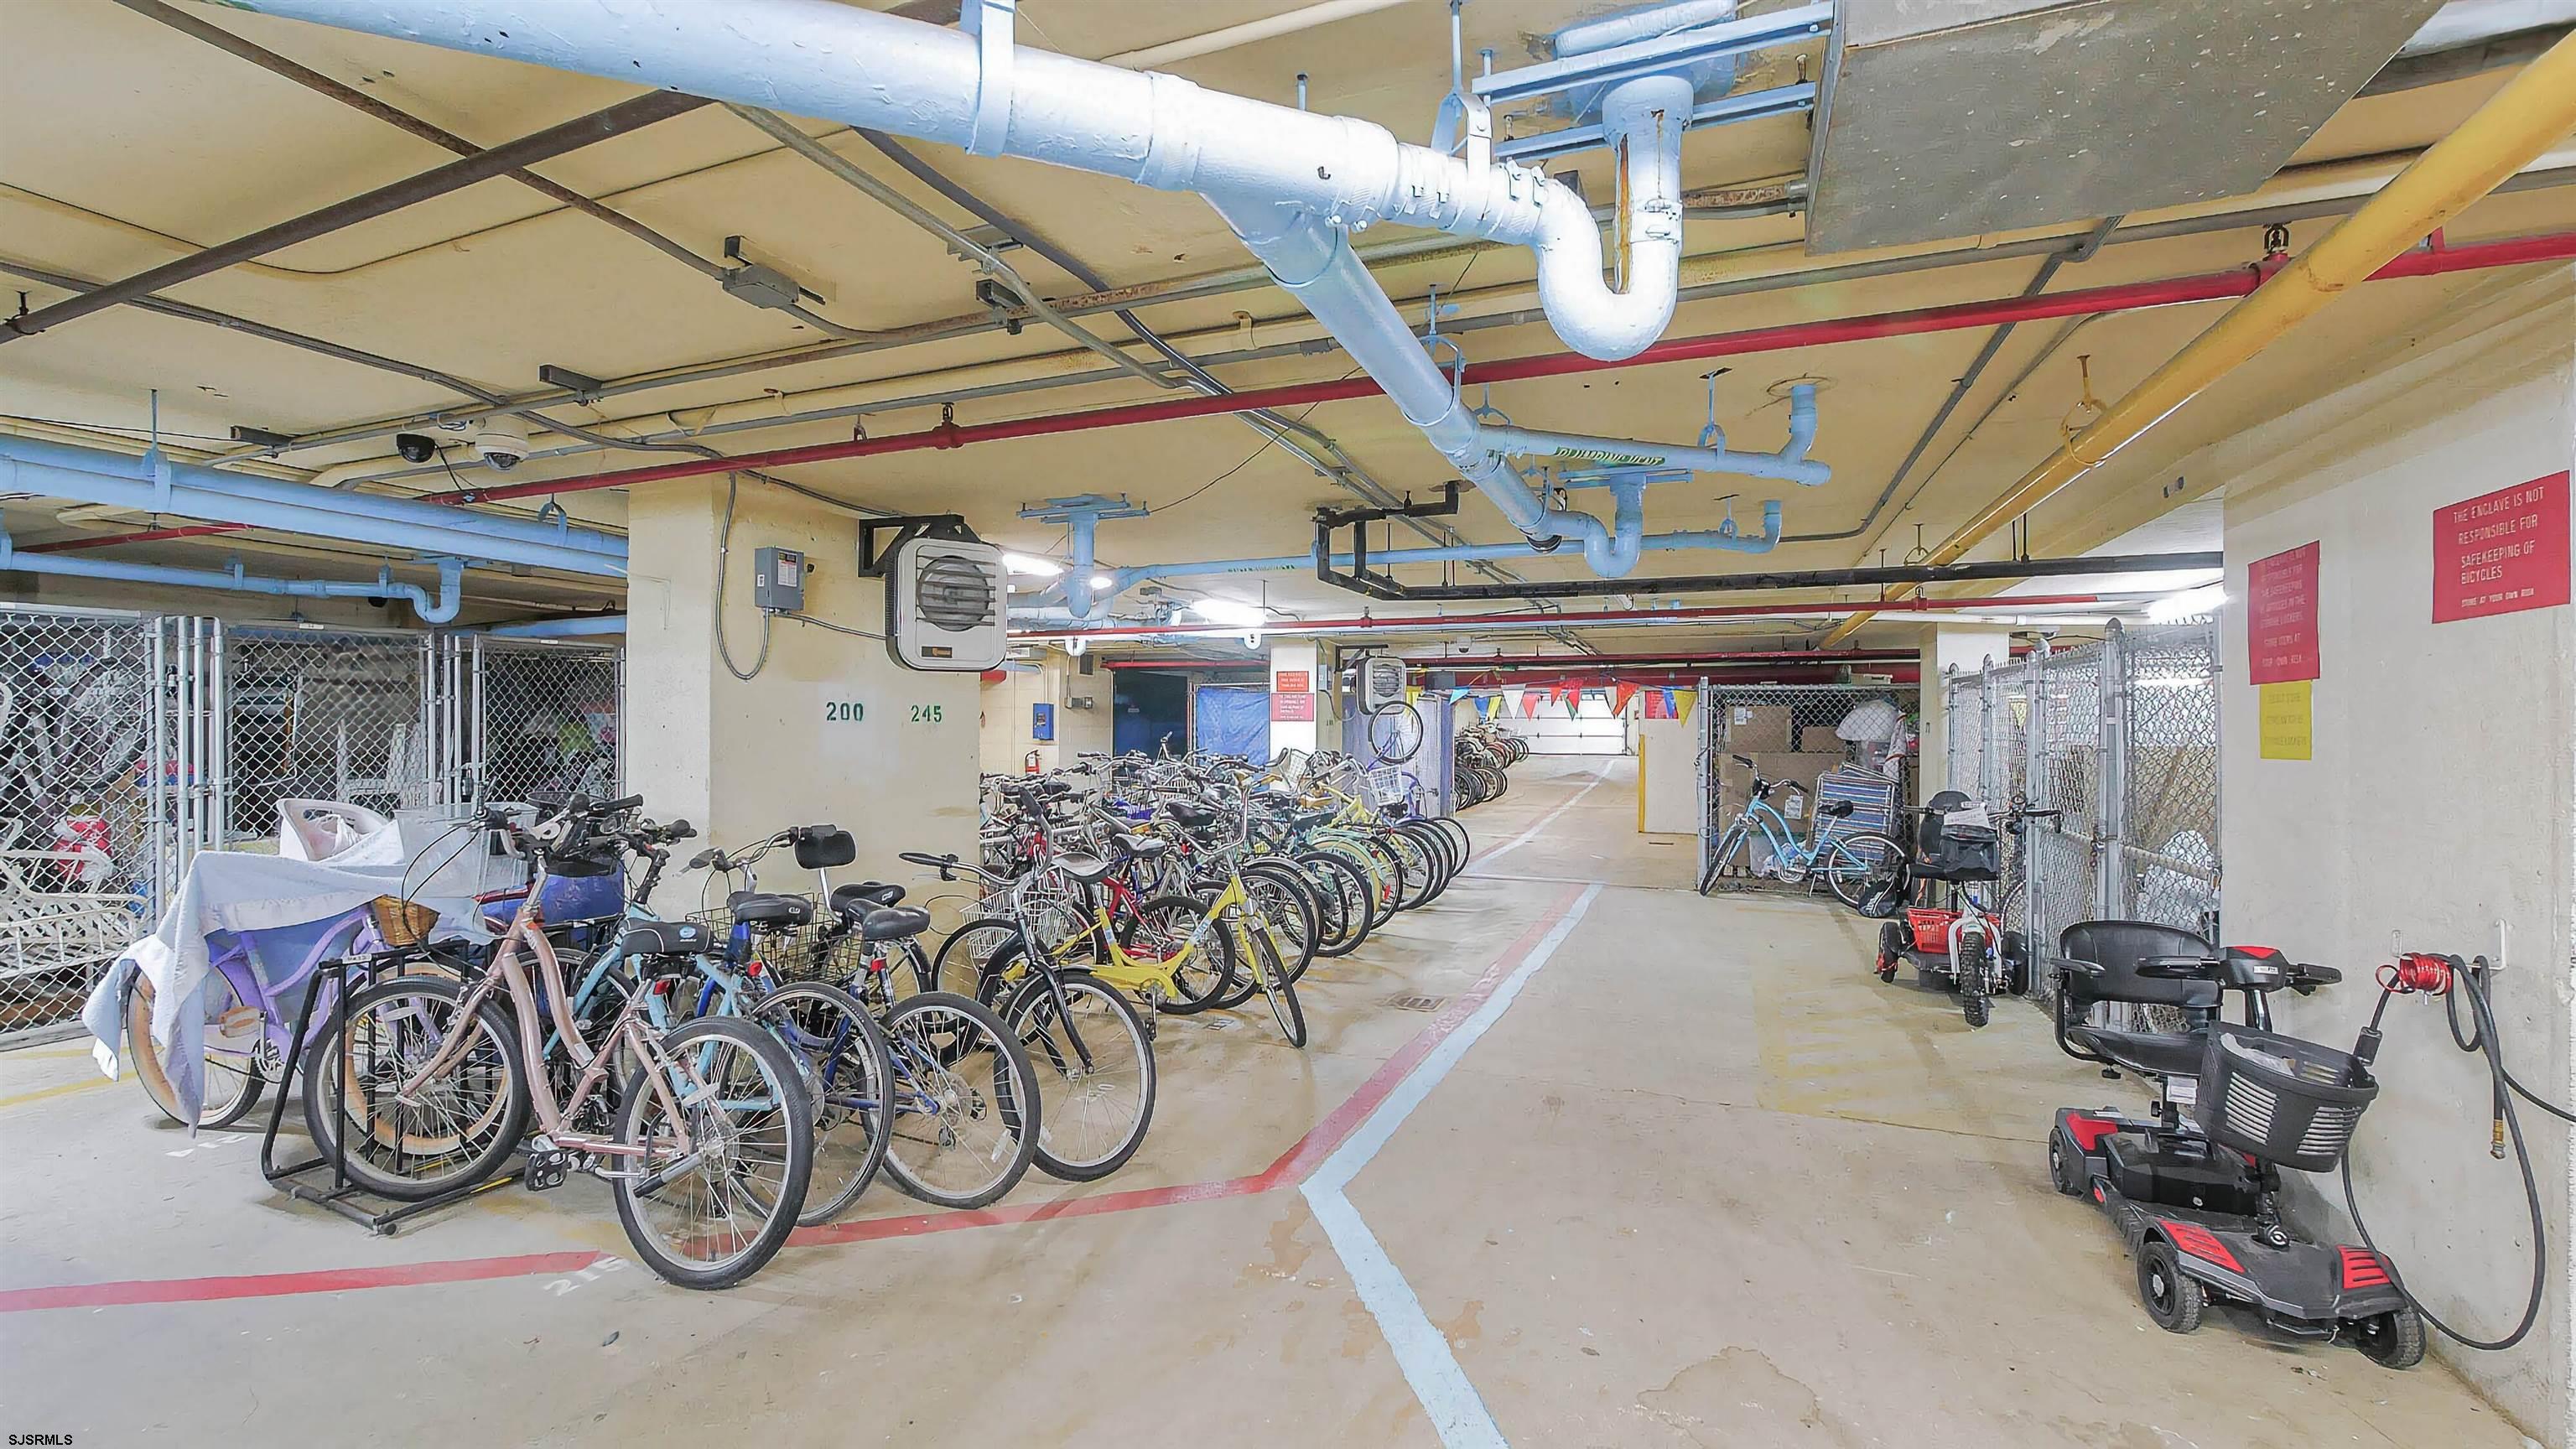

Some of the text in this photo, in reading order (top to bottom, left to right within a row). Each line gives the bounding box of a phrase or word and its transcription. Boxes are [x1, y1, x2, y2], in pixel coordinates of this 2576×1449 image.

[2454, 486, 2544, 523] THE ENCLAVE IS NOT
[2459, 514, 2538, 544] RESPONSIBLE FOR
[2461, 540, 2536, 569] SAFEKEEPING OF
[2461, 566, 2503, 584] BICYCLES
[825, 701, 864, 721] 200
[910, 704, 943, 723] 245
